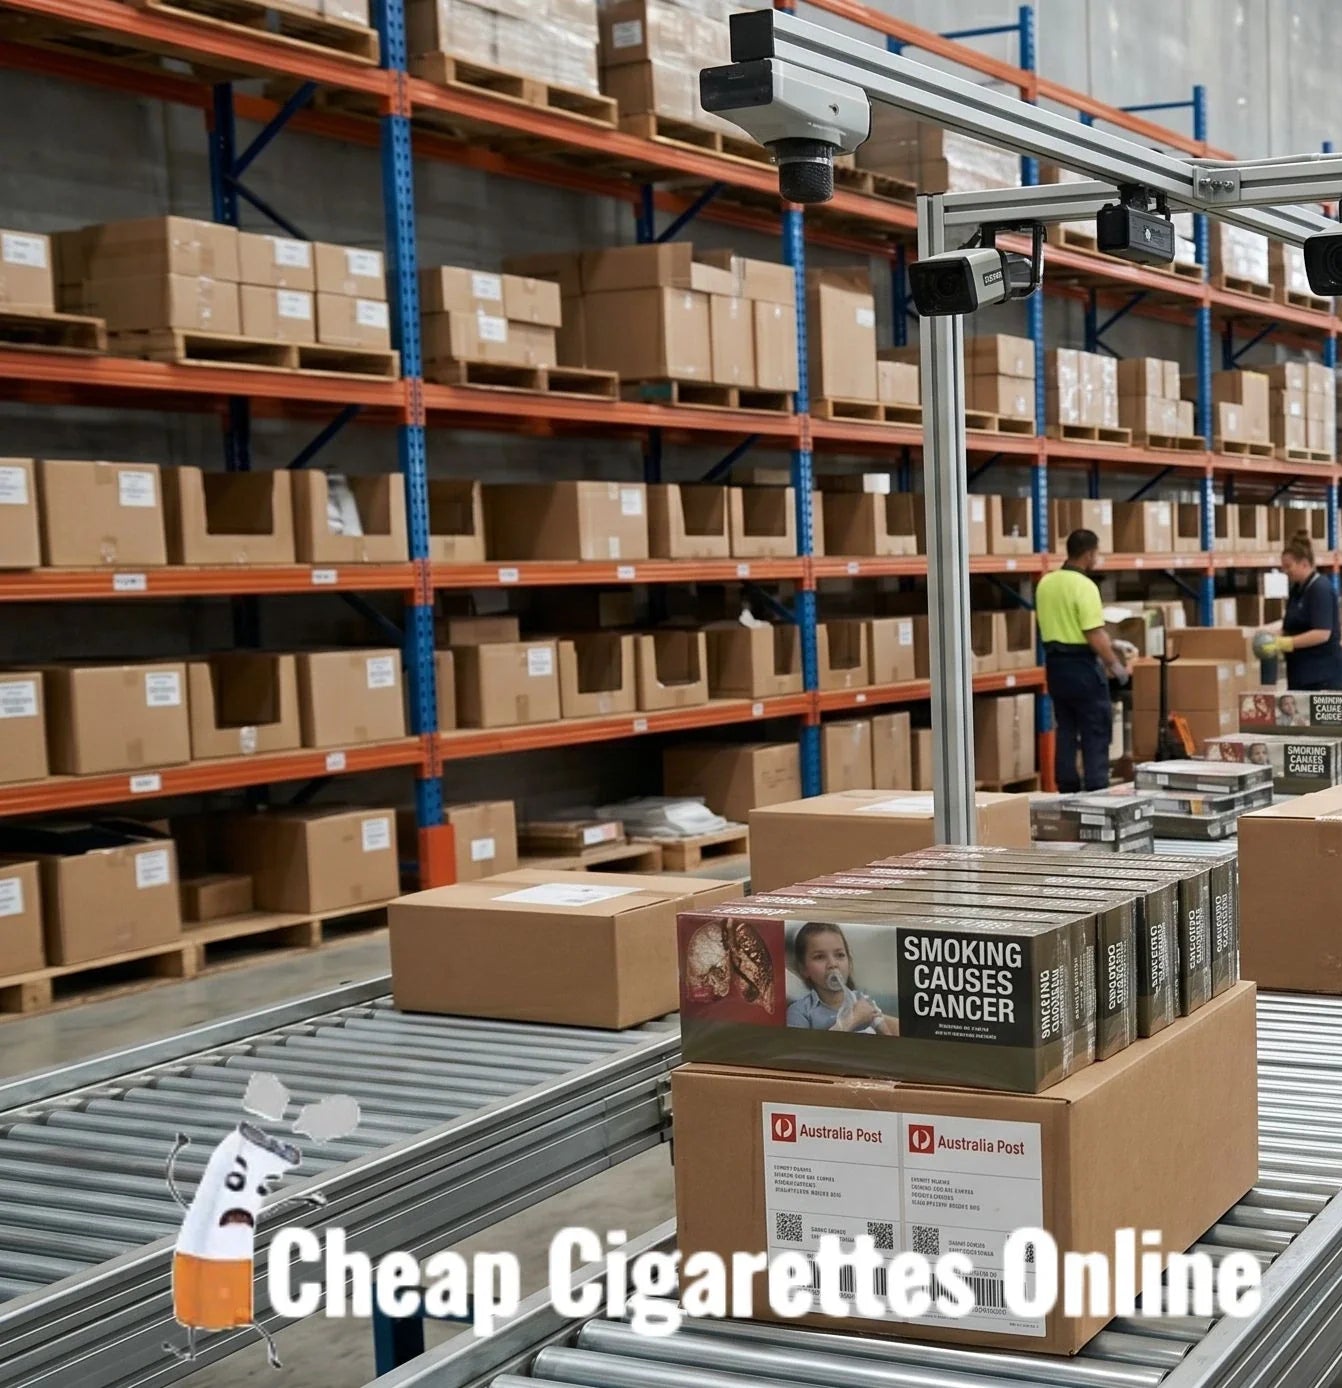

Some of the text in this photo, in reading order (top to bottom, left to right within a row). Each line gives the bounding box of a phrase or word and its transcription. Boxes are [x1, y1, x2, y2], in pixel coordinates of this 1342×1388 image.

[904, 936, 1022, 968] SMOKING
[914, 964, 1013, 995] CAUSES
[913, 992, 1015, 1023] CANCER
[800, 1124, 882, 1143] Australia Post
[938, 1135, 1025, 1156] Australia Post
